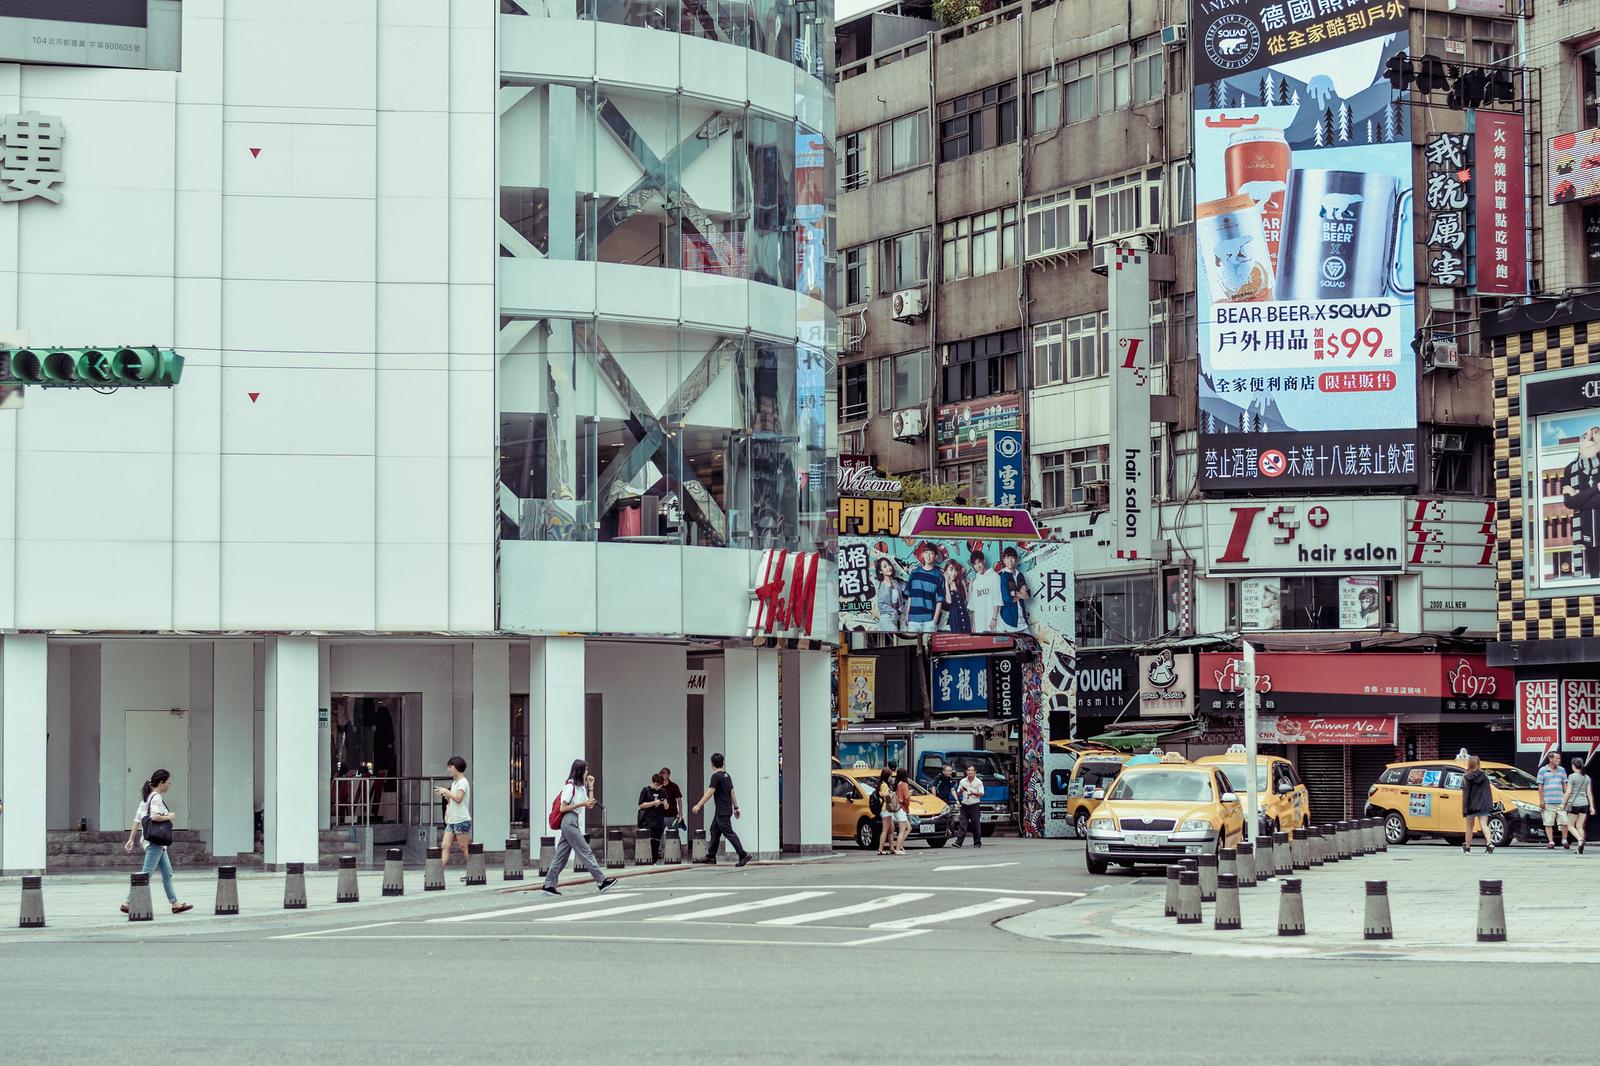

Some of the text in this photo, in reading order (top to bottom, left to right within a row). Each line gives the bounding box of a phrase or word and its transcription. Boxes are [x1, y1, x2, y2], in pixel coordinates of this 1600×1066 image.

[1217, 29, 1247, 38] SQUAD
[1267, 0, 1405, 56] 從全家酷到戶外
[1322, 232, 1352, 243] BEER
[1323, 223, 1353, 233] BEAR
[1216, 303, 1392, 324] BEAR BEER X SQUAD
[1217, 329, 1309, 353] 戶外用品
[1326, 327, 1384, 359] $99
[1216, 373, 1391, 394] 全家便利商店 限量販售
[1204, 443, 1416, 479] 禁止酒駕 未滿十八歲禁止飲酒
[838, 465, 902, 493] Welcome
[1125, 448, 1142, 538] hair salon
[838, 497, 904, 536] 門町
[936, 511, 1014, 528] Xi-Men Walker
[1298, 543, 1397, 562] hair salon
[754, 547, 820, 636] H&M
[1032, 569, 1067, 603] 浪
[1444, 600, 1455, 609] ALL
[1455, 600, 1467, 609] NEW
[687, 674, 706, 689] H&M
[1526, 682, 1558, 698] SALE
[1001, 674, 1012, 715] TOUGH
[1526, 697, 1558, 713] SALE
[1308, 718, 1387, 732] Taiwan No.1
[1527, 713, 1558, 730] SALE
